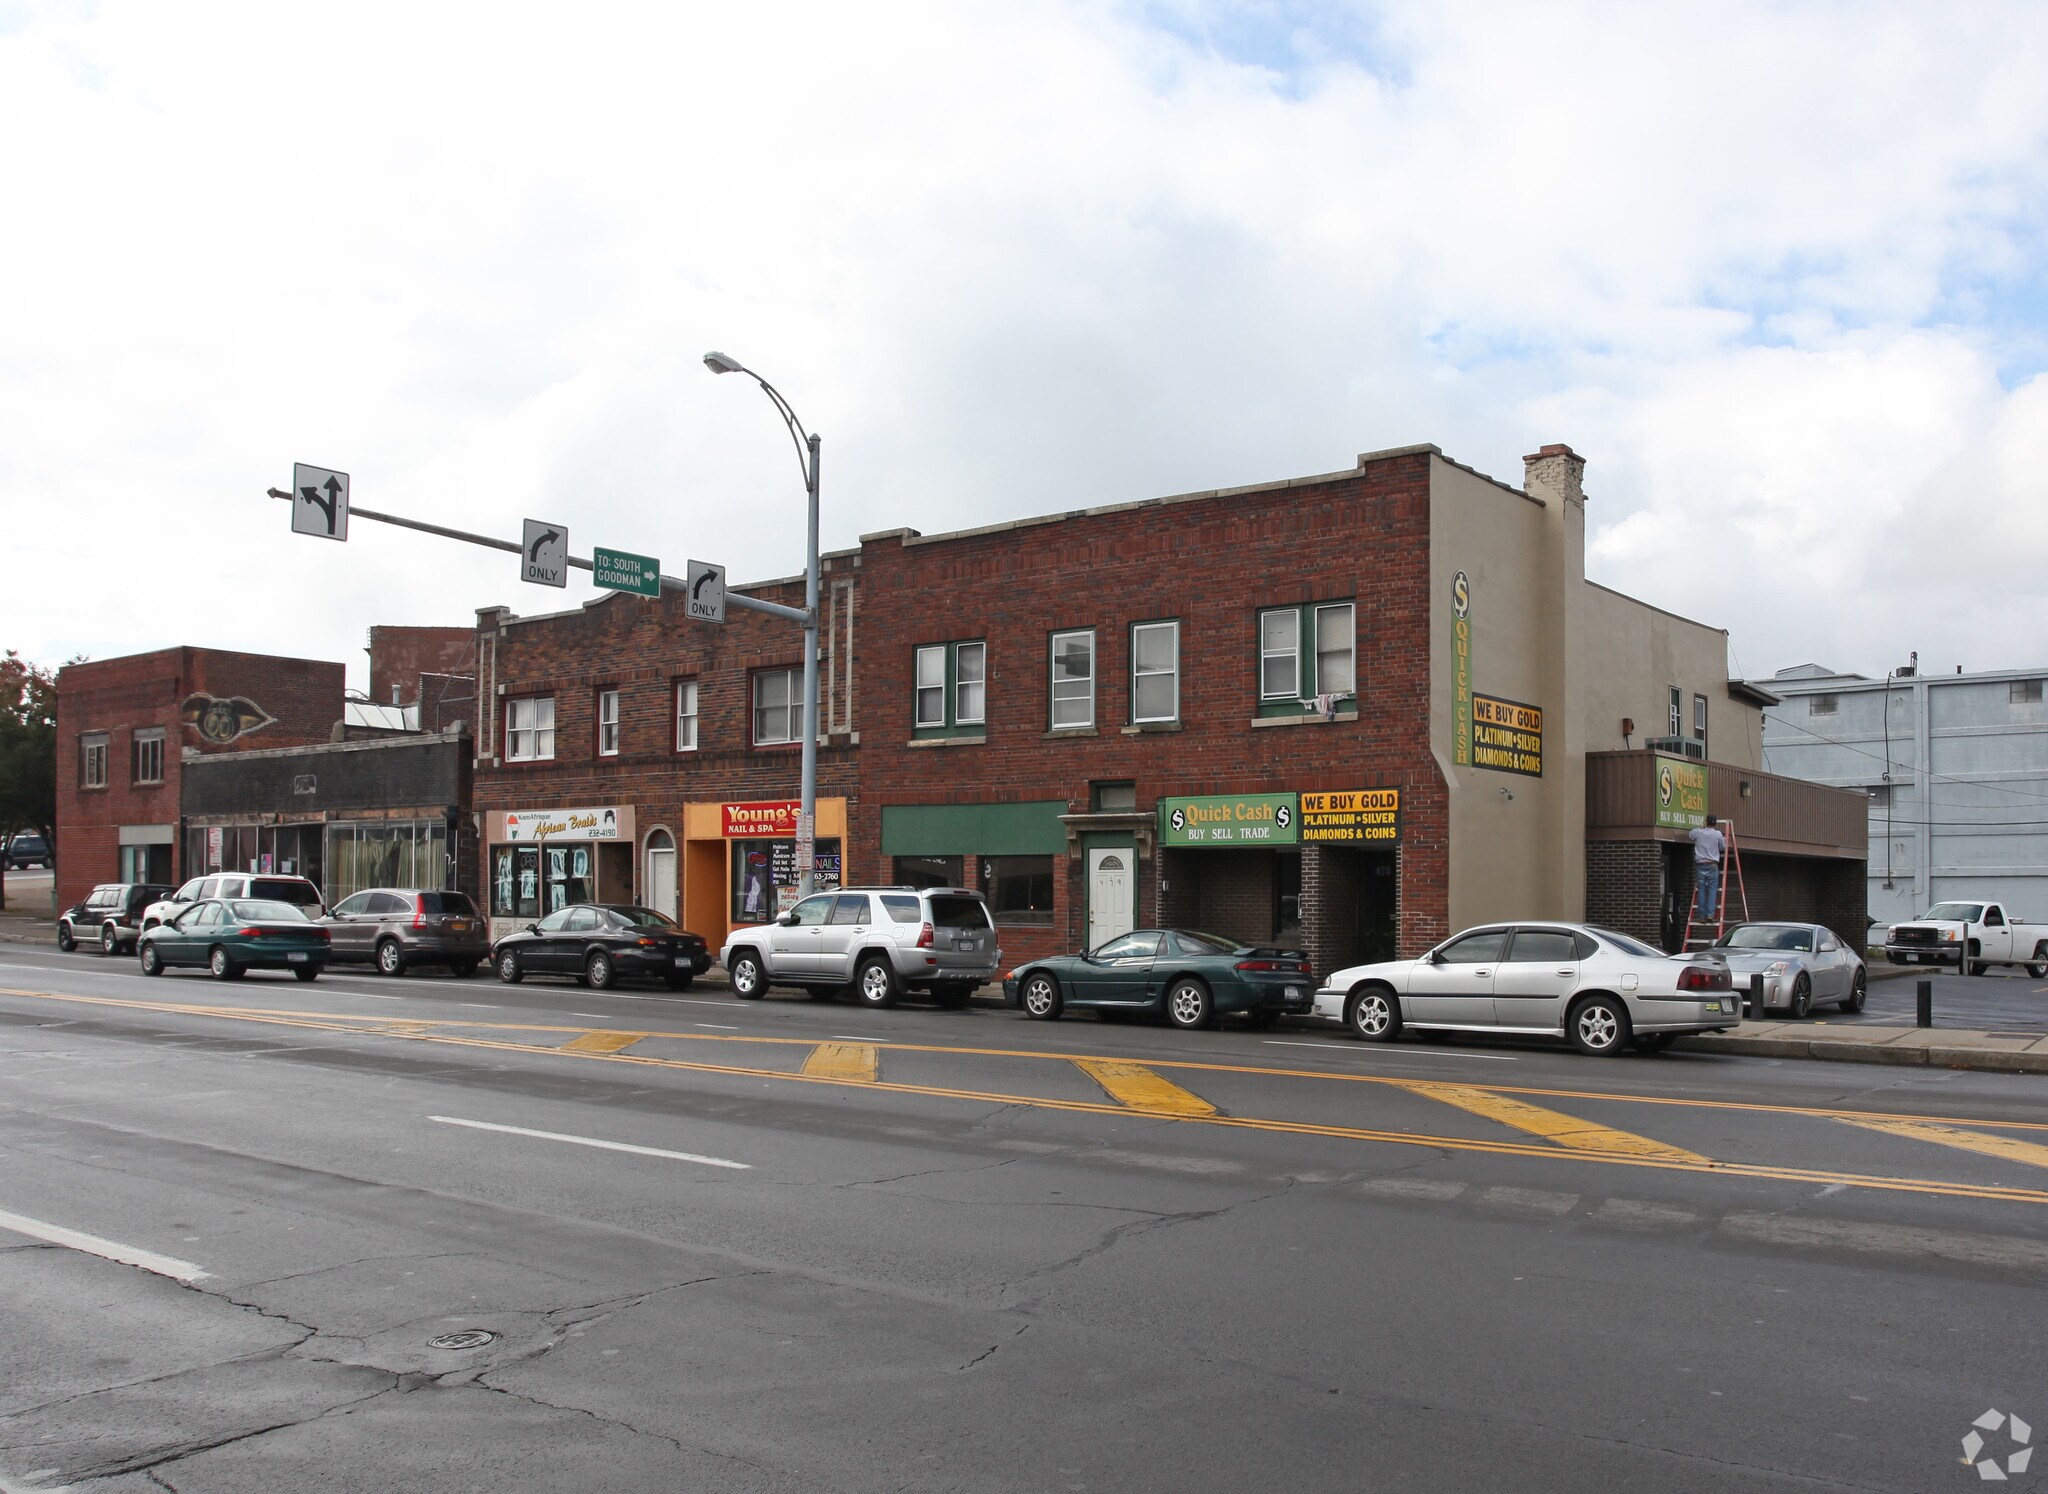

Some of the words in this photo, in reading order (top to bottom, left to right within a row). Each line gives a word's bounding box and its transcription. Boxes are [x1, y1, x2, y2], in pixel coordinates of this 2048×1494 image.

[597, 554, 611, 566] TO:
[614, 558, 641, 573] SOUTH
[529, 566, 558, 581] ONLY
[597, 569, 641, 587] GOODMAN
[691, 602, 717, 617] ONLY
[1455, 620, 1469, 703] QUICK
[1475, 700, 1492, 720] WE
[1496, 705, 1514, 724] BUY
[1517, 709, 1540, 729] GOLD
[1456, 707, 1469, 764] CASH
[1474, 746, 1513, 768] DIAMONDS
[1513, 753, 1519, 769] &
[1519, 753, 1541, 774] COINS
[1675, 766, 1704, 792] Quick
[1304, 795, 1324, 810] WE
[1330, 794, 1355, 809] BUY
[1361, 793, 1396, 808] GOLD
[1680, 789, 1703, 811] Cash
[727, 804, 802, 825] Young's
[1186, 804, 1232, 827] Quick
[1235, 802, 1273, 821] Cash
[1660, 810, 1671, 822] BUY
[1673, 812, 1686, 824] SELL
[533, 820, 567, 840] African
[568, 813, 598, 830] Braids
[589, 828, 616, 837] 232-4190
[728, 825, 748, 833] NAIL
[748, 825, 756, 833] &
[757, 825, 774, 833] SPA
[1188, 828, 1206, 840] BUY
[1211, 828, 1233, 840] SELL
[1240, 827, 1270, 839] TRADE
[1303, 828, 1355, 840] DIAMONDS
[1355, 828, 1363, 839] &
[1365, 827, 1396, 839] COINS
[815, 857, 840, 870] NAILS
